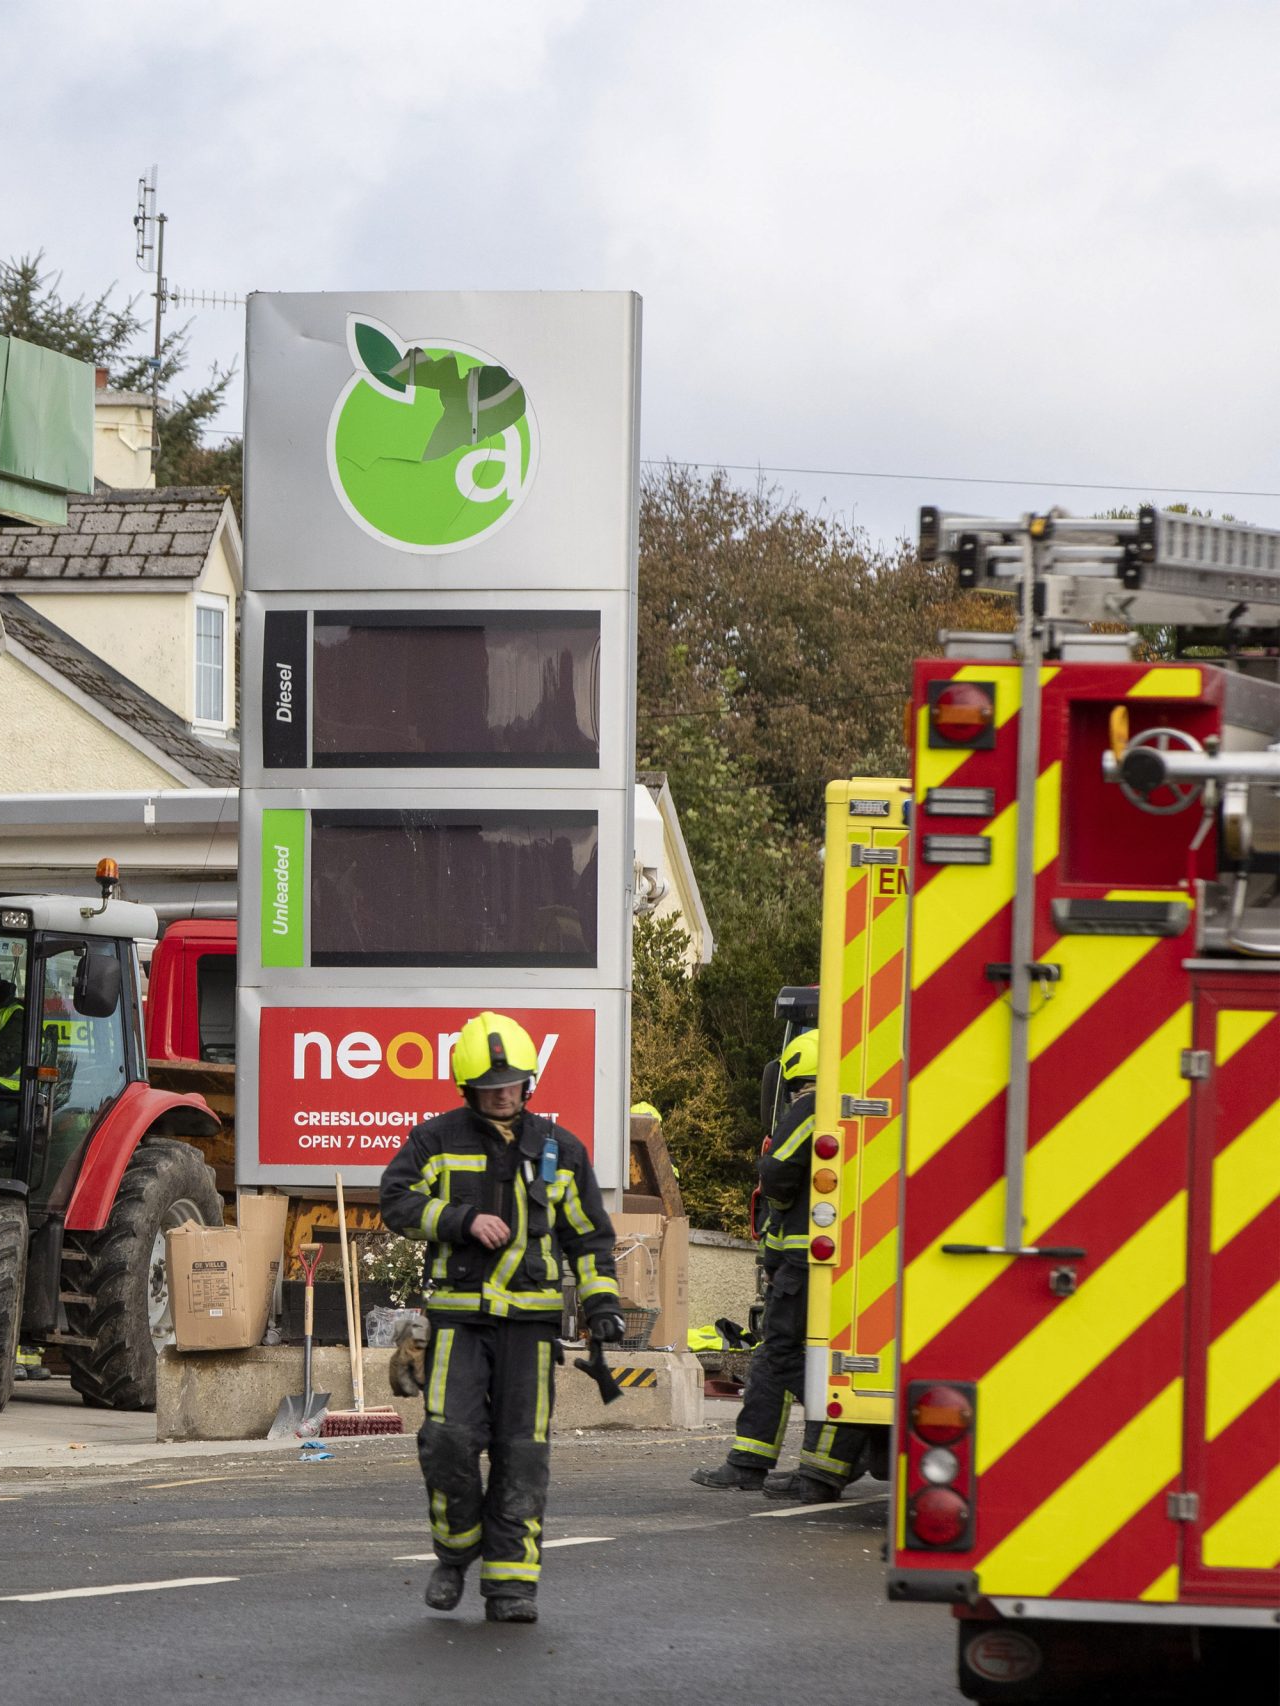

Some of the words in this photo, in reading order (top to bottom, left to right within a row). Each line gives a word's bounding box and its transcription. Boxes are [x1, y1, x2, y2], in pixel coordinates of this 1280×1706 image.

[276, 663, 293, 723] Diesel
[272, 845, 291, 936] Unleaded
[293, 1111, 418, 1126] CREESLOUGH
[298, 1135, 342, 1148] OPEN
[346, 1135, 355, 1148] 7
[360, 1135, 401, 1148] DAYS
